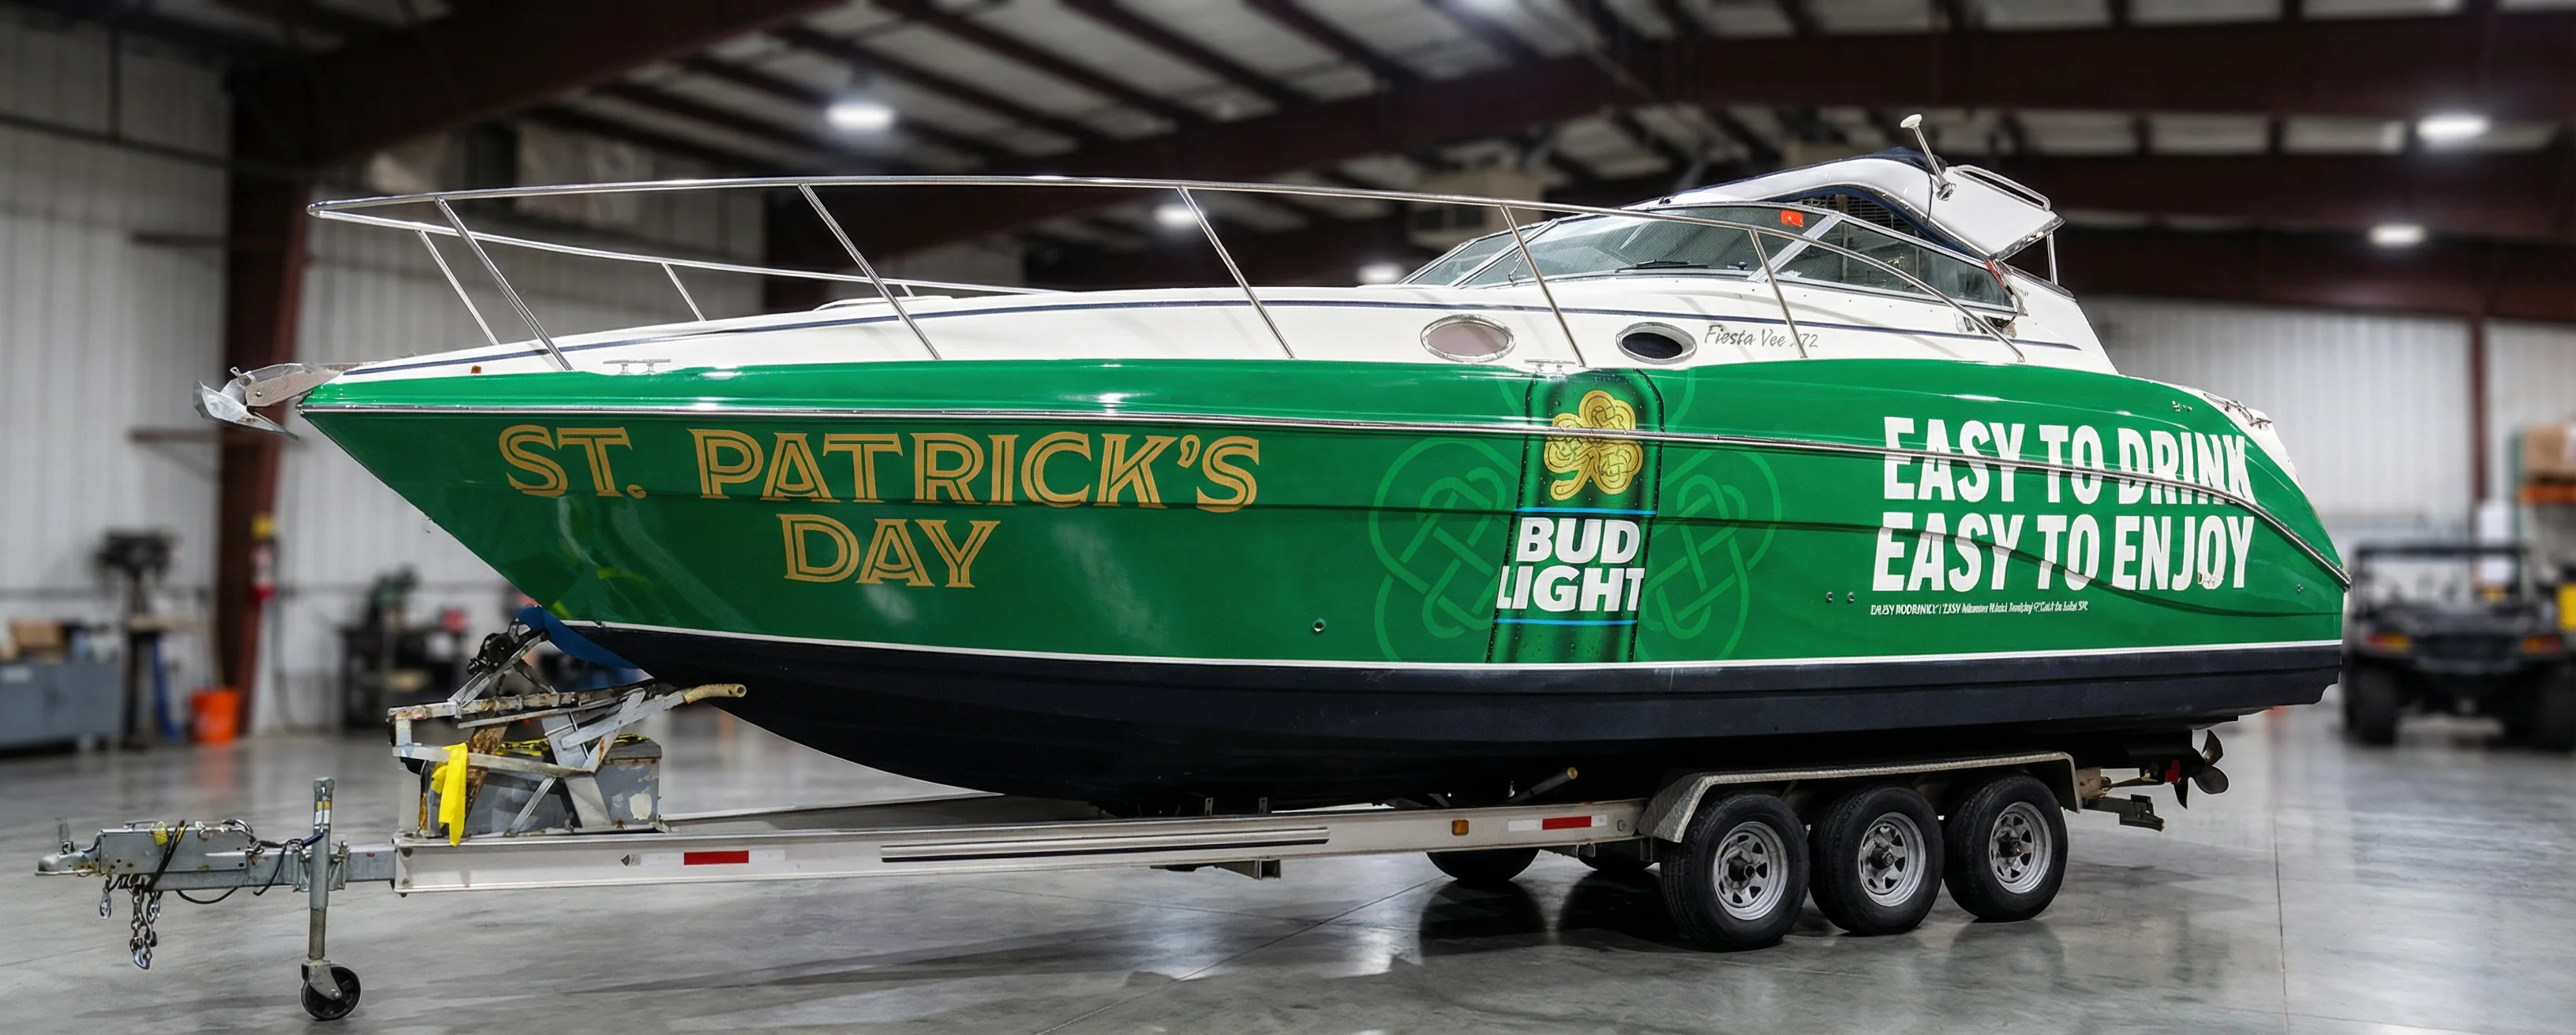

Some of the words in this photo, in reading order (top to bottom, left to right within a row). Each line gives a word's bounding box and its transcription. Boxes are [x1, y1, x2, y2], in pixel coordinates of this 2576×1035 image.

[1705, 324, 1756, 346] Fiesta
[1761, 328, 1786, 347] Vee
[498, 424, 647, 499] ST.
[687, 427, 1260, 513] PATRICK'S
[1884, 417, 2025, 502] EASY
[2039, 424, 2103, 504] TO
[2117, 427, 2258, 506] DRINK
[776, 514, 1000, 588] DAY
[1515, 517, 1641, 564] BUD
[1873, 512, 2025, 592] EASY
[2037, 514, 2100, 592] TO
[2112, 515, 2255, 591] ENJOY
[1496, 565, 1646, 611] LIGHT
